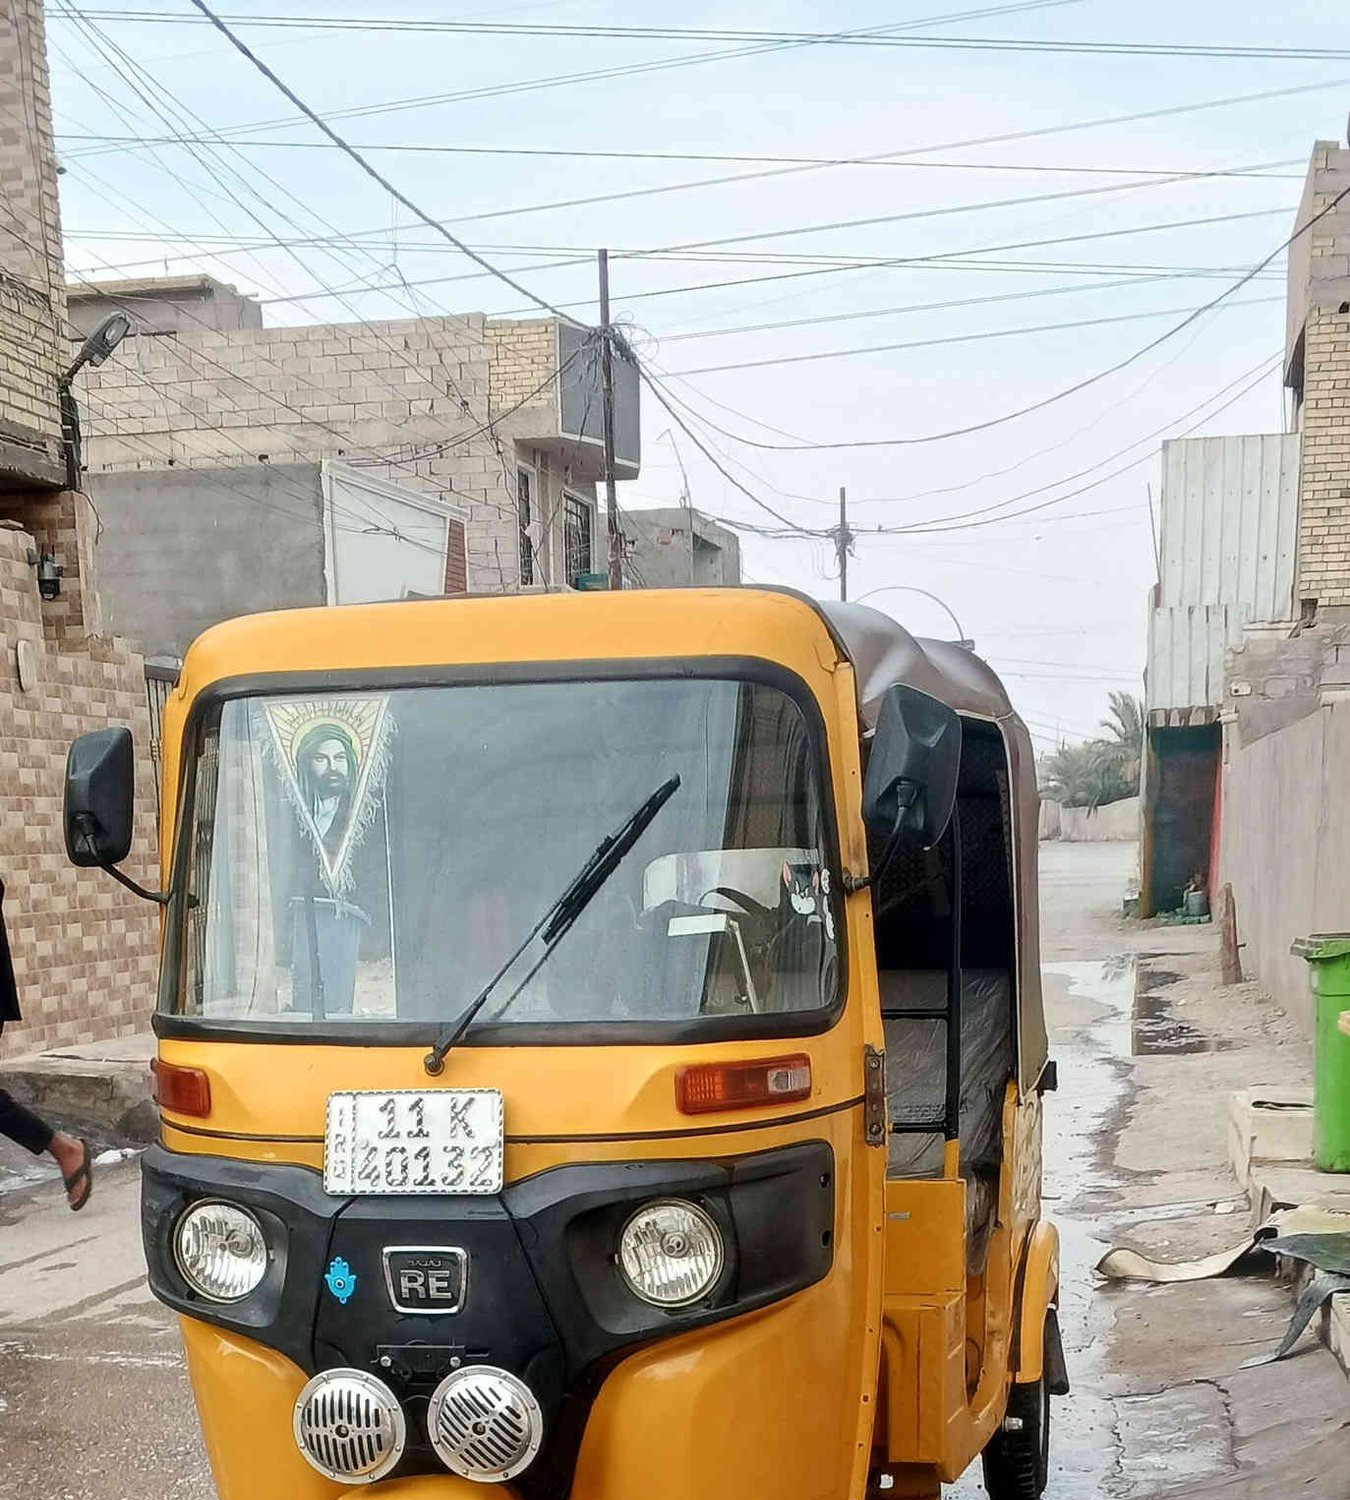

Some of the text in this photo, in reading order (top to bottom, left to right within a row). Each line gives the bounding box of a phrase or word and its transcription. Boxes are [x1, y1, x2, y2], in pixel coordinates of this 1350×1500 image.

[378, 1097, 475, 1138] 11 K
[357, 1145, 493, 1187] 40132
[400, 1269, 452, 1299] RE
